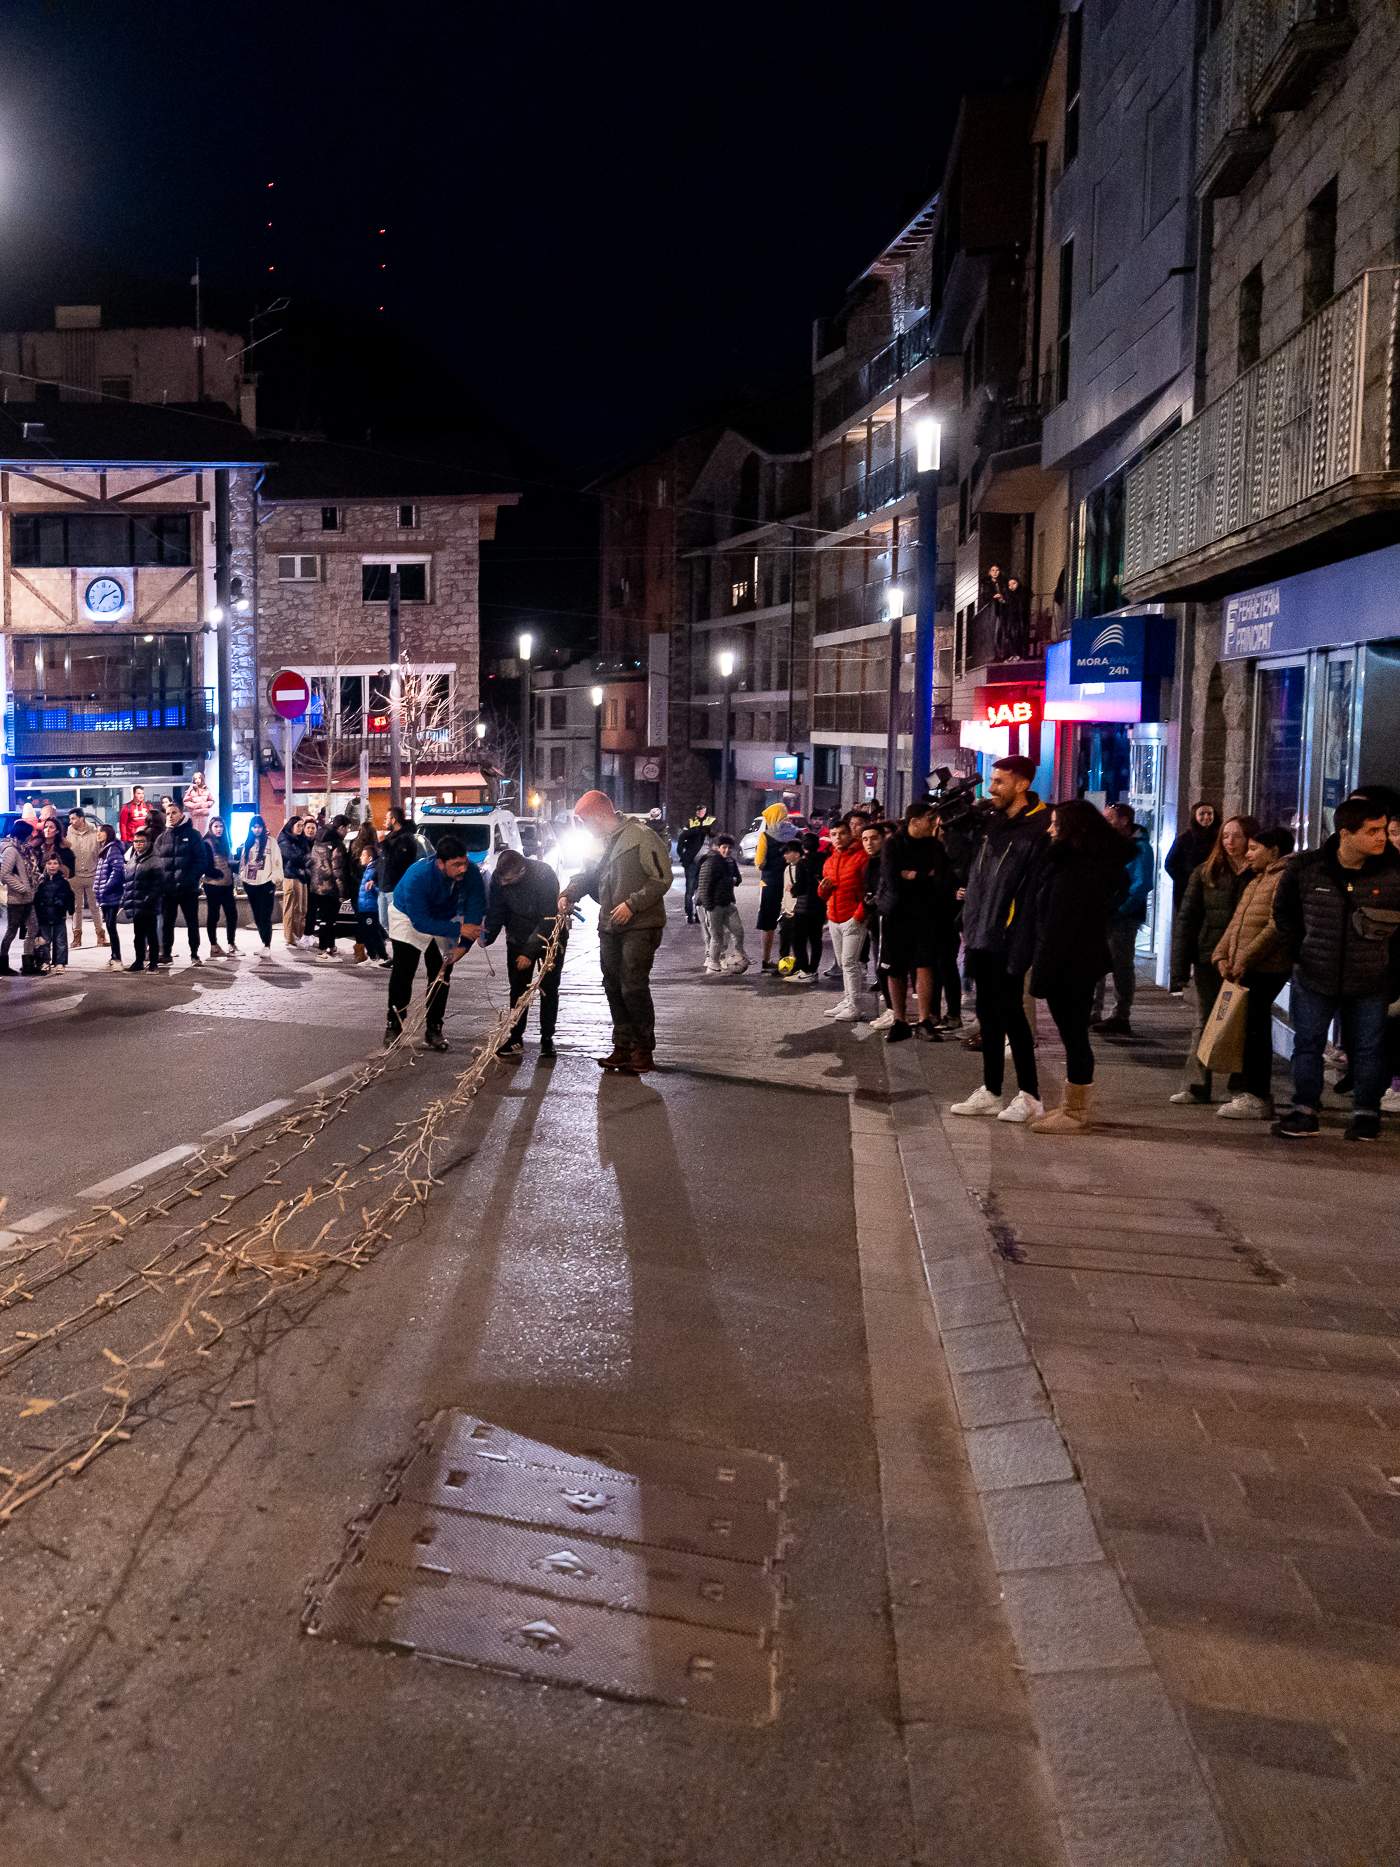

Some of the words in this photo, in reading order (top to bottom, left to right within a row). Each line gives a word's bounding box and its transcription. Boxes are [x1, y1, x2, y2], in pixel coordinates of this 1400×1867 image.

[1238, 587, 1280, 622] FERRETERIA
[1108, 666, 1129, 675] 24h
[429, 797, 484, 814] RETOLACIÓ
